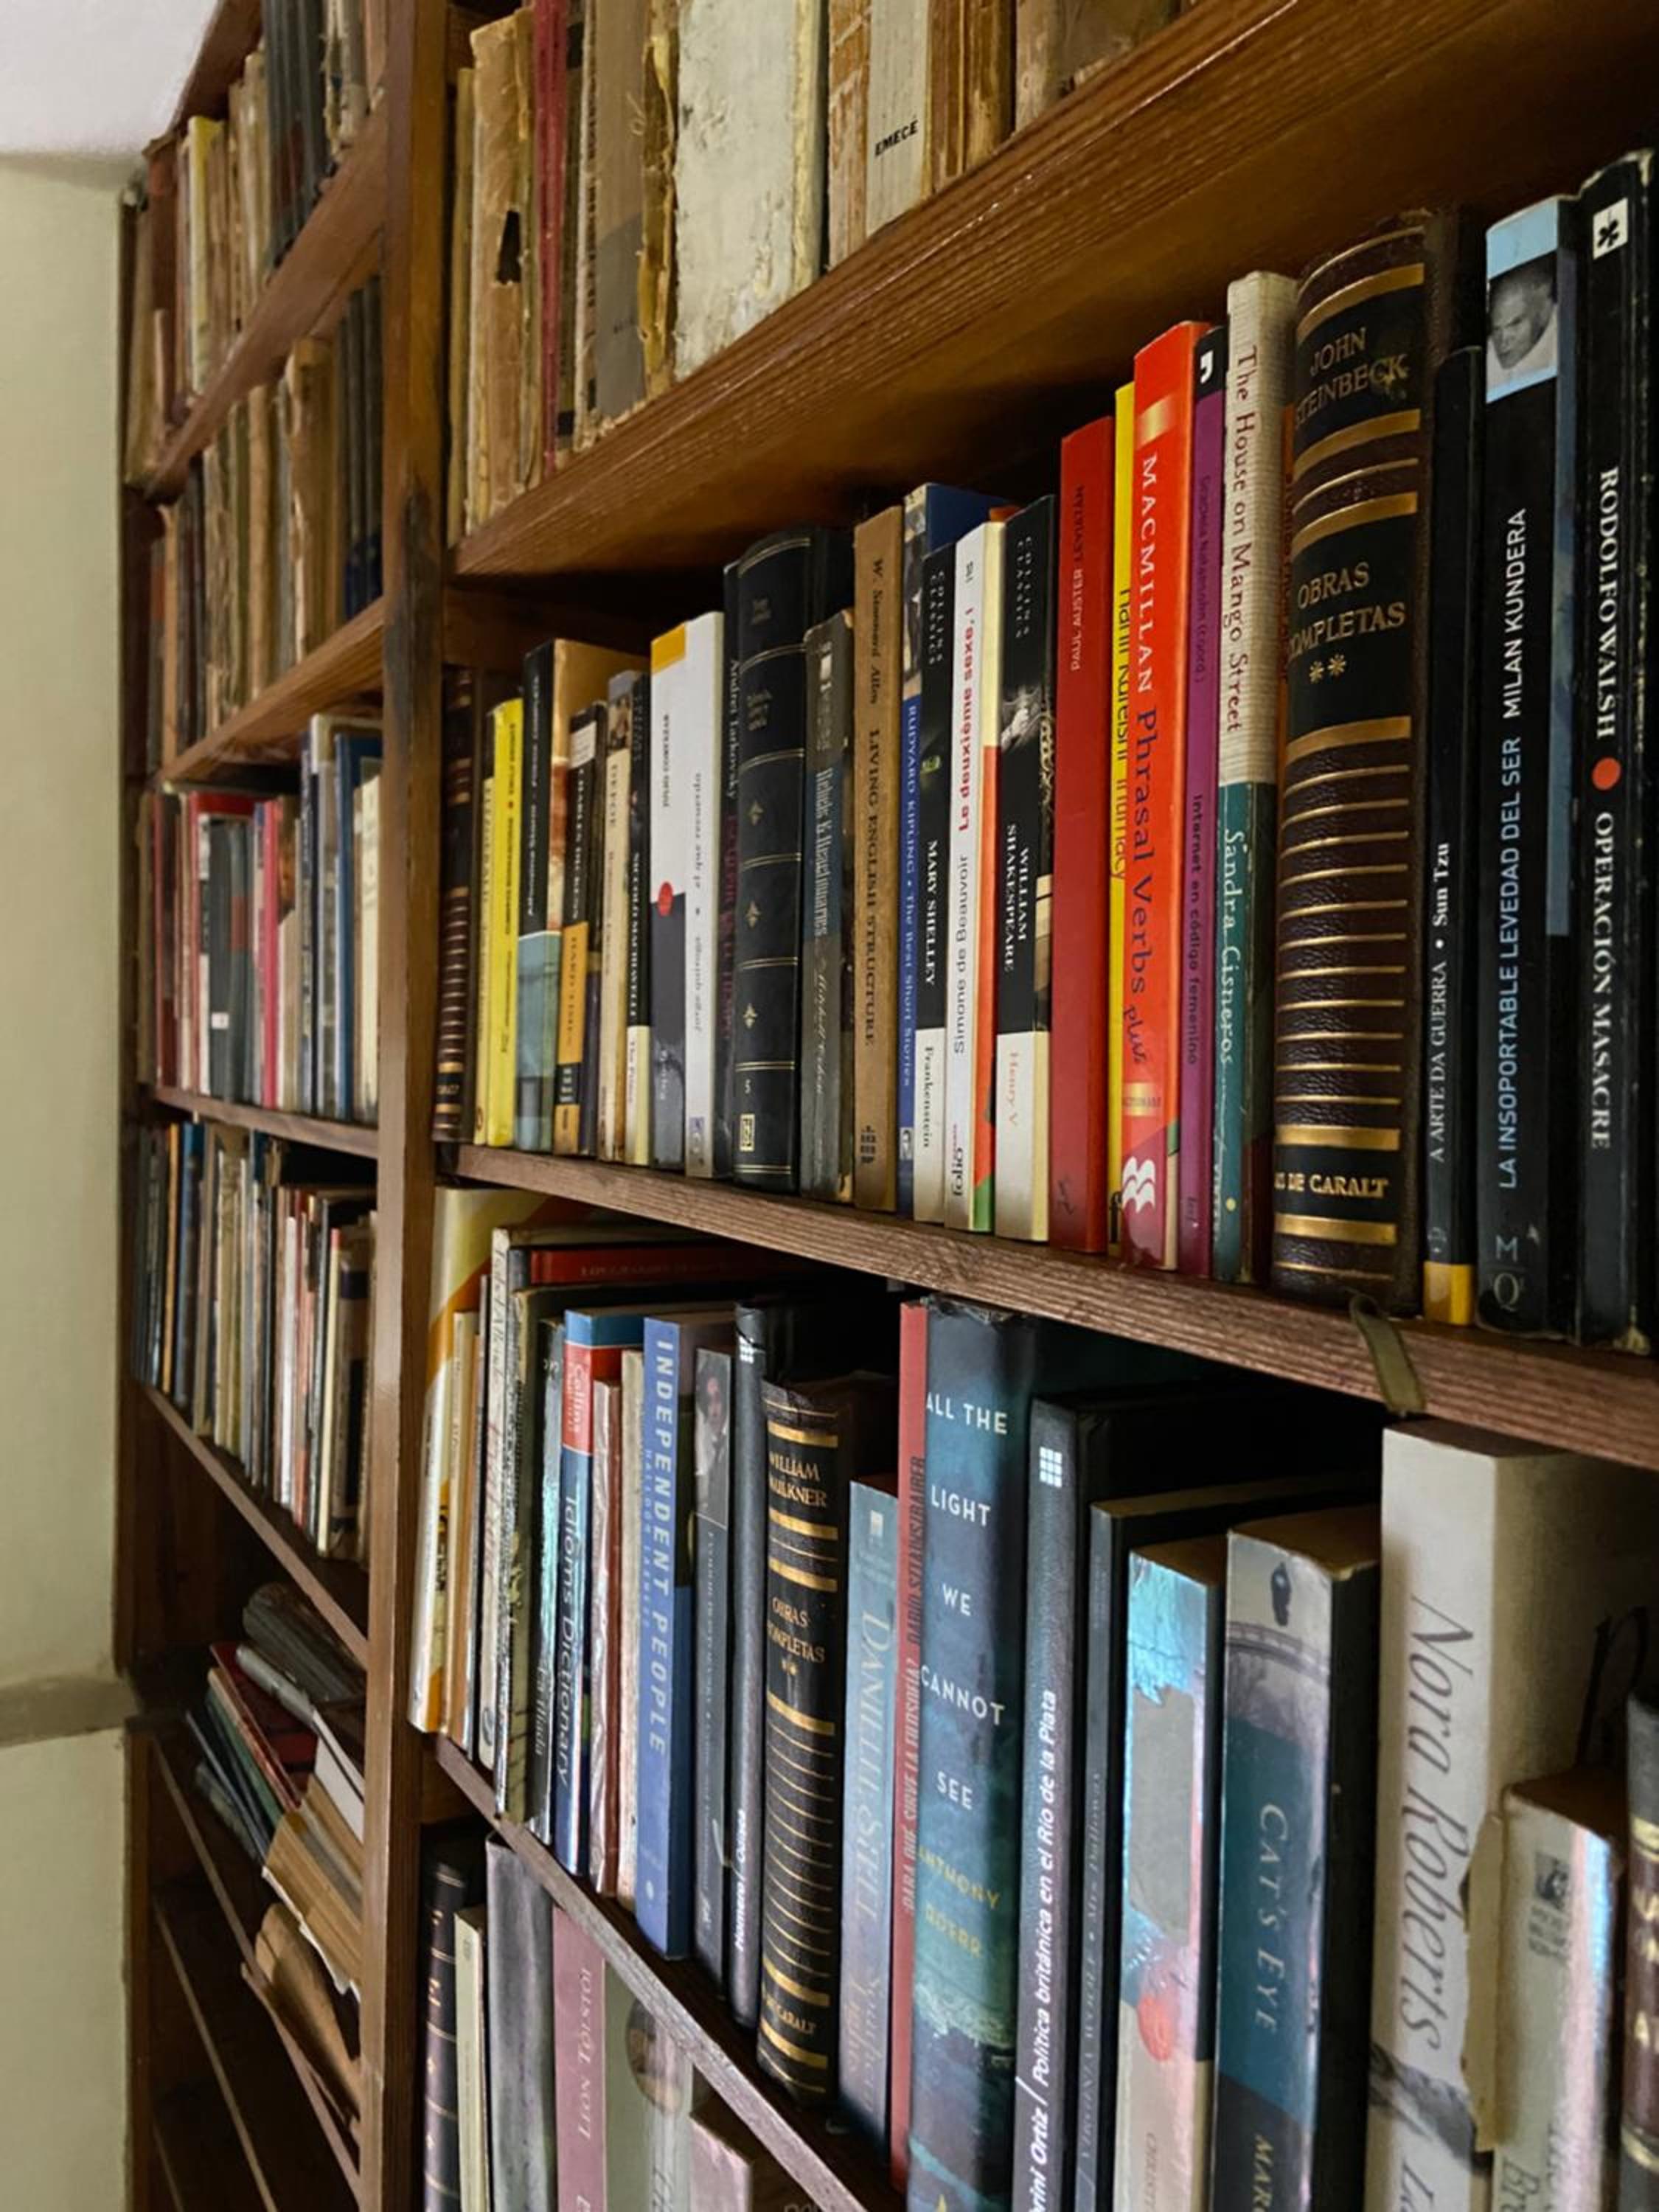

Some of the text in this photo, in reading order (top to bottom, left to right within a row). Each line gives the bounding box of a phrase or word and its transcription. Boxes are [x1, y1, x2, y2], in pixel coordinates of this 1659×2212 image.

[1310, 327, 1367, 377] JOHN
[1223, 345, 1258, 732] The House on Mango Street
[1071, 569, 1083, 670] PAUL AUSTER
[1297, 561, 1369, 610] OBRAS
[1596, 467, 1619, 739] RODOLFO WALSH
[908, 706, 917, 793] RUDYARD
[959, 688, 972, 799] deuxième
[1123, 454, 1158, 1065] MACMILLAN Phrasal Verbs plus
[906, 801, 915, 874] KIPLING
[959, 807, 970, 832] Le
[1498, 508, 1526, 1189] LA INSOPORTABLE LEVEDAD DEL SER MILAN KUNDERA
[865, 729, 880, 1046] LIVING ENGLISH STRUCTURE
[925, 840, 938, 985] MARY SHELLEY
[1004, 824, 1017, 972] SHAKESPEARE
[1018, 847, 1029, 940] WILLIAM
[1188, 794, 1203, 1065] Internet en código femenino
[954, 856, 968, 1054] Simone de Beauvoir
[1220, 829, 1244, 1065] Sandra Cisneros
[1591, 812, 1616, 1149] OPERACIÓN MASACRE
[1429, 841, 1450, 1163] A ARTE DA GUERRA Sun Tzu
[923, 1046, 934, 1147] Frankenstein
[1008, 1052, 1019, 1106] Henry
[950, 1147, 964, 1197] folio
[1309, 1173, 1389, 1200] CARALT
[926, 1391, 1007, 1435] ALL THE
[649, 1340, 673, 1755] INDEPENDENT PEOPLE
[931, 1484, 992, 1526] LIGHT
[557, 1496, 577, 1786] Idioms Dictionary
[942, 1583, 971, 1615] WE
[921, 1664, 1004, 1726] CANNOT
[1039, 1688, 1056, 1745] Plata
[937, 1771, 973, 1811] SEE
[1038, 1774, 1054, 1804] de
[1039, 1750, 1054, 1771] la
[1037, 1809, 1054, 1846] Río
[1037, 1849, 1053, 1871] el
[1400, 1594, 1474, 2050] Nora Roberts
[1041, 1877, 1053, 1905] en
[1034, 1909, 1051, 2003] británica
[1032, 2008, 1049, 2086] Política
[1031, 2107, 1048, 2165] Ortiz
